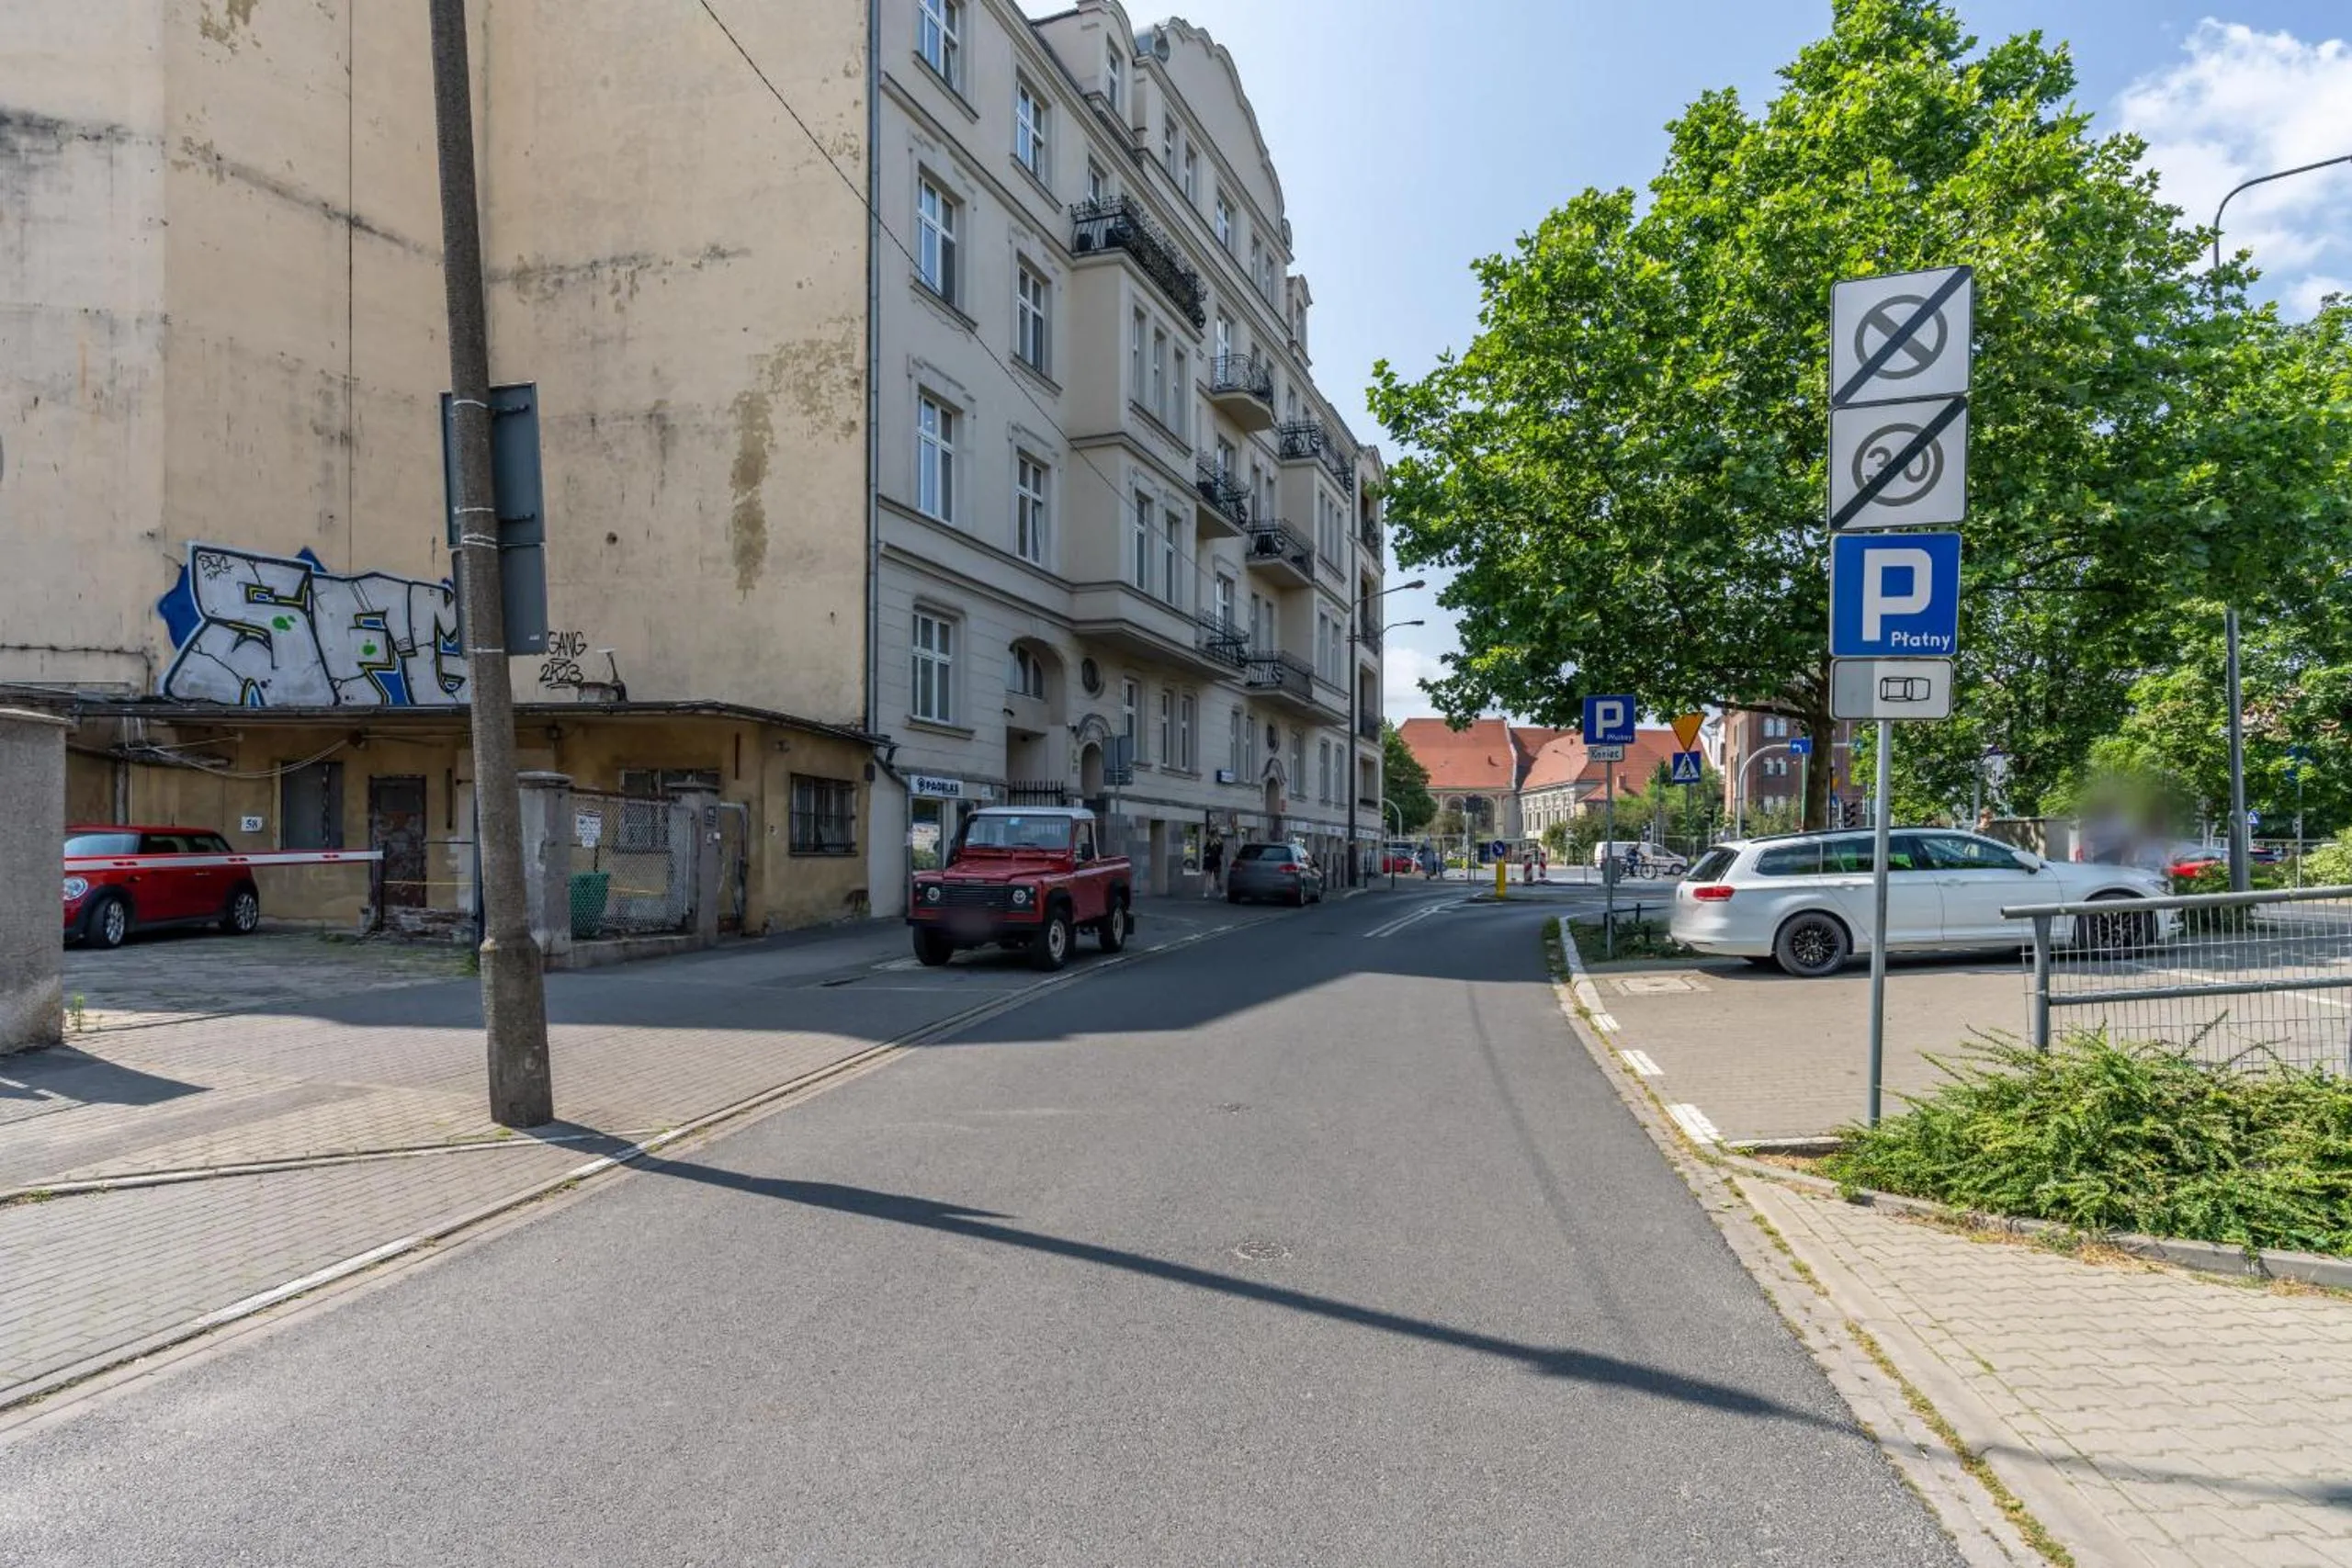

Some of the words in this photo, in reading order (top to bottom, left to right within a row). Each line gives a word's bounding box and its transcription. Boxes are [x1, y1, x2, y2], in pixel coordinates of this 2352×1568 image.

[1865, 446, 1930, 484] 30
[1862, 547, 1933, 641] P
[548, 631, 587, 658] GANG
[1891, 631, 1951, 650] Płatny
[1595, 700, 1624, 739] P
